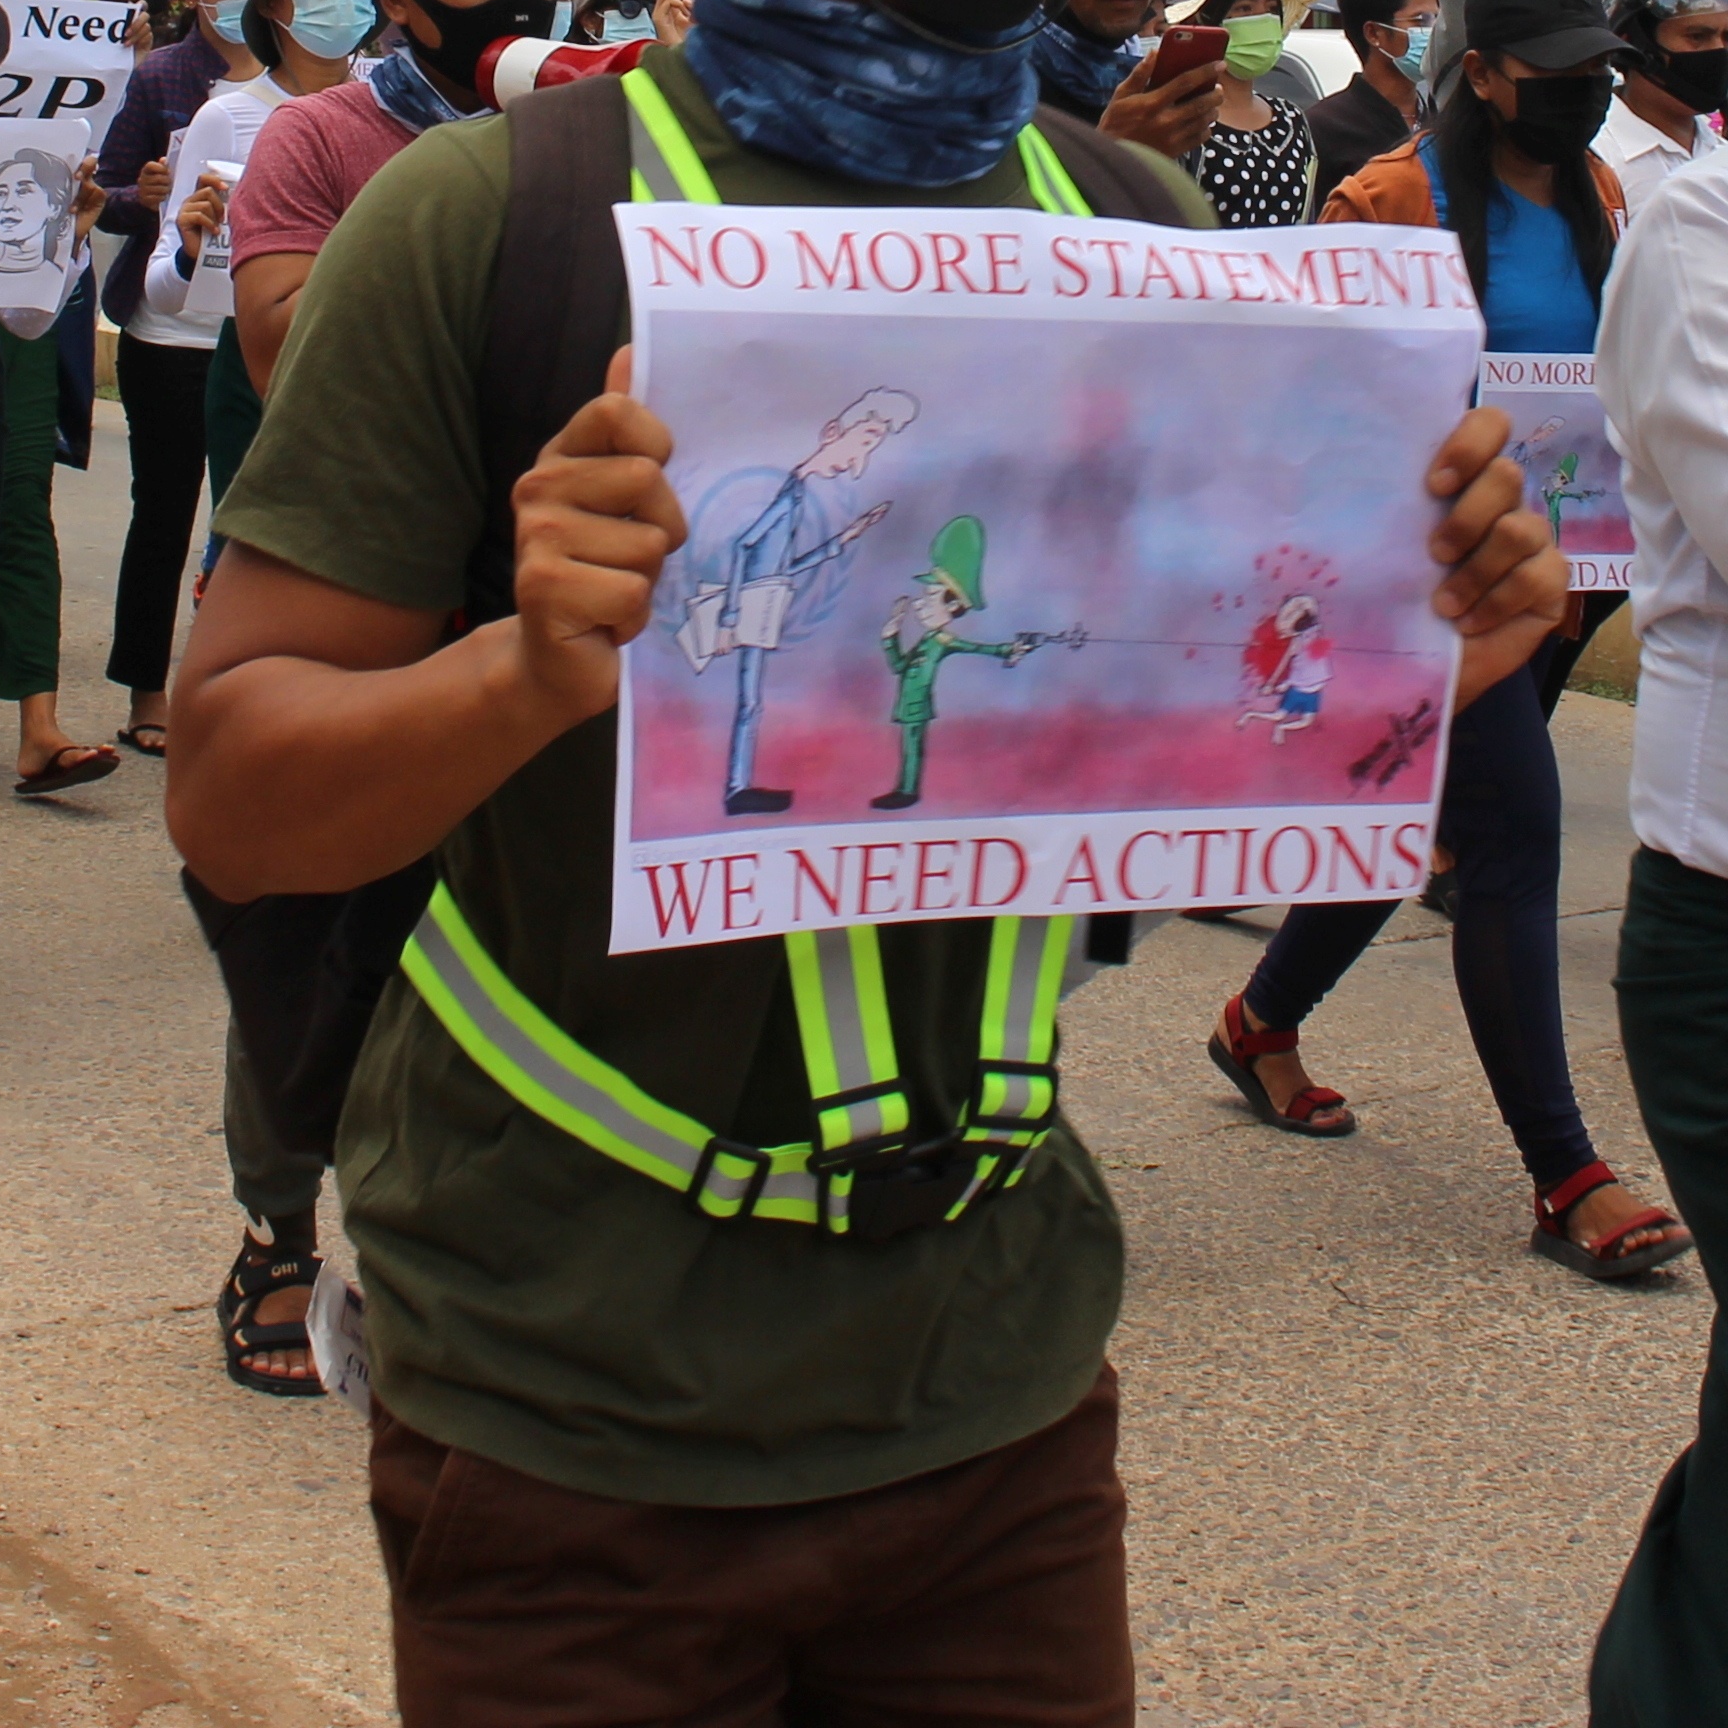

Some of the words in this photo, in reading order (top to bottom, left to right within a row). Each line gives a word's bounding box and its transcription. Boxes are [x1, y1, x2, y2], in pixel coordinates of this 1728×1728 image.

[22, 5, 135, 44] Need
[638, 226, 770, 290] NO
[786, 229, 1031, 296] MORE
[1485, 360, 1524, 384] NO
[641, 852, 764, 939] WE
[786, 838, 1032, 923] NEED
[1051, 822, 1428, 906] ACTIONS
